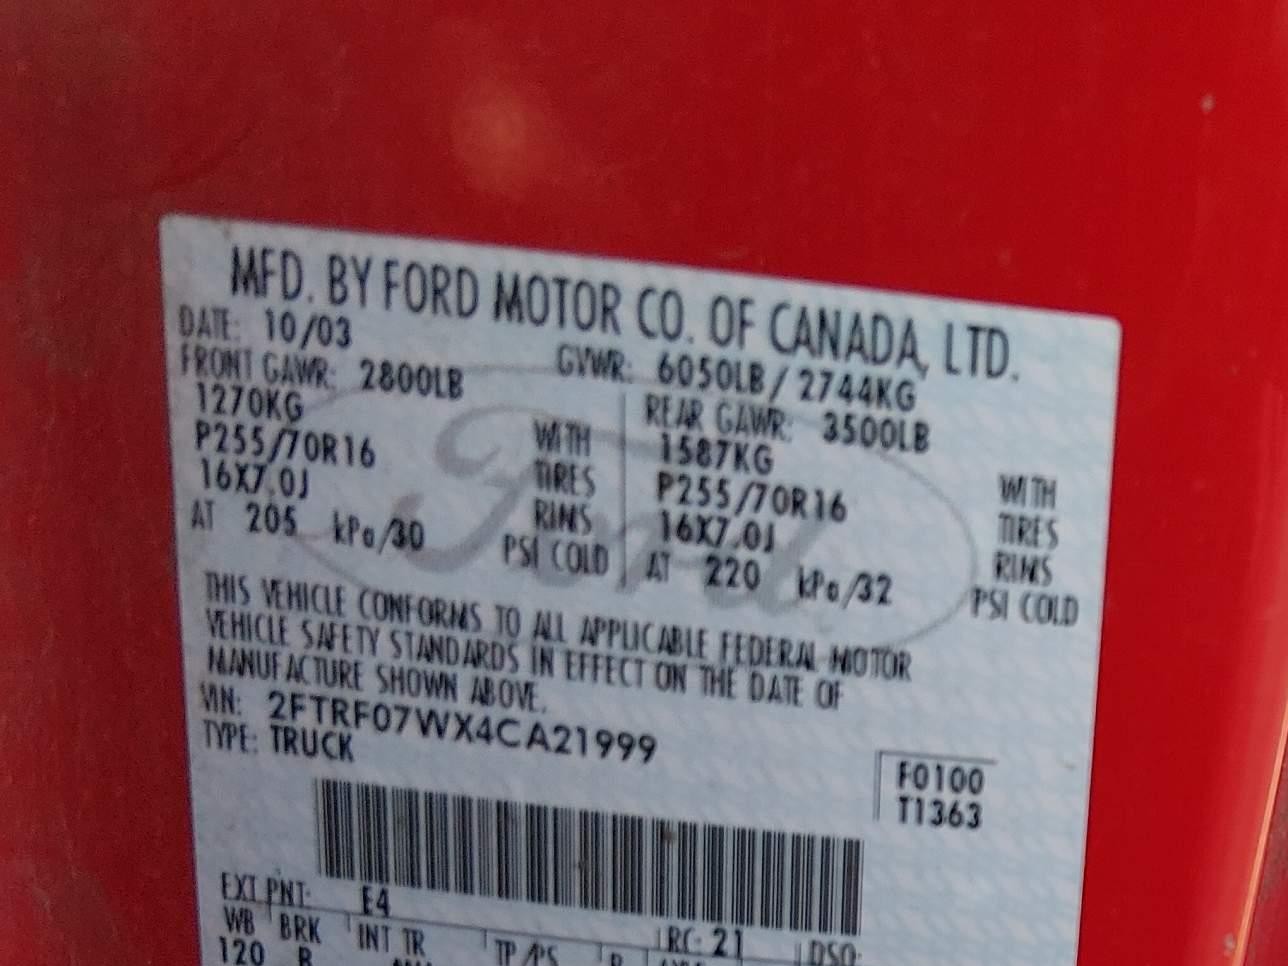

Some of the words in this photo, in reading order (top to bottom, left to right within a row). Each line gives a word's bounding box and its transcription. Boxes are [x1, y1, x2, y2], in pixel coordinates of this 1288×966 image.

[180, 304, 240, 341] DATE:
[265, 309, 352, 349] 10/03
[231, 246, 313, 302] MFD.
[328, 254, 372, 309] BY
[384, 260, 479, 318] FORD
[494, 272, 621, 334] MOTOR
[638, 287, 693, 344] CO.
[711, 295, 754, 348] OF
[770, 302, 929, 380] CANADA,
[945, 322, 1019, 382] LTD.
[181, 344, 252, 380] FRONT
[264, 351, 336, 390] GAWR:
[360, 359, 464, 399] 2800LB
[557, 344, 632, 384] GVWR:
[197, 383, 303, 421] 1270KG
[646, 393, 703, 430] REAR
[716, 400, 793, 442] GAWR:
[824, 411, 930, 453] 3500LB
[196, 421, 376, 469] P255/70R16
[534, 419, 591, 457] WITH
[662, 432, 773, 476] 1587KG
[202, 461, 309, 499] 16X7.0J
[534, 457, 596, 498] TIRES
[657, 471, 848, 523] P255/70R16
[999, 473, 1056, 510] WITH
[191, 500, 214, 530] AT
[247, 503, 298, 537] 205
[534, 498, 592, 536] RIMS
[662, 509, 774, 553] 16X7.0J
[999, 512, 1059, 550] TIRES
[504, 534, 539, 569] PSI
[552, 540, 609, 576] COLD
[647, 552, 670, 583] AT
[706, 554, 760, 590] 220
[994, 550, 1052, 586] RIMS
[205, 571, 250, 606] THIS
[262, 575, 345, 618] VEHICLE
[359, 588, 482, 632] CONFORMS
[496, 604, 520, 639] TO
[534, 610, 565, 643] ALL
[580, 615, 706, 660] APPLICABLE
[721, 630, 815, 672] FEDERAL
[830, 645, 912, 681] MOTOR
[972, 587, 1008, 621] PSI
[1020, 592, 1079, 627] COLD
[206, 608, 288, 646] VEHICLE
[302, 620, 380, 656] SAFETY
[390, 629, 518, 673] STANDARDS
[531, 645, 554, 678] IN
[565, 650, 645, 688] EFFECT
[655, 661, 686, 694] ON
[701, 665, 736, 699] THE
[750, 672, 802, 707] DATE
[816, 679, 843, 711] OF
[207, 646, 362, 691] MANUFACTURE
[375, 664, 458, 703] SHOWN
[472, 676, 546, 714] ABOVE.
[200, 680, 241, 716] VIN:
[269, 690, 657, 765] 2FTRF07WX4CA21999
[204, 719, 257, 754] TYPE:
[270, 723, 354, 763] TRUCK
[899, 761, 984, 795] F0100
[899, 796, 982, 829] T1363
[221, 872, 256, 901] EXT
[362, 886, 391, 917] E4
[224, 906, 255, 936] WB
[280, 913, 321, 944] BRK
[359, 923, 391, 952] INT
[403, 927, 426, 956] TR
[713, 927, 743, 959] 21
